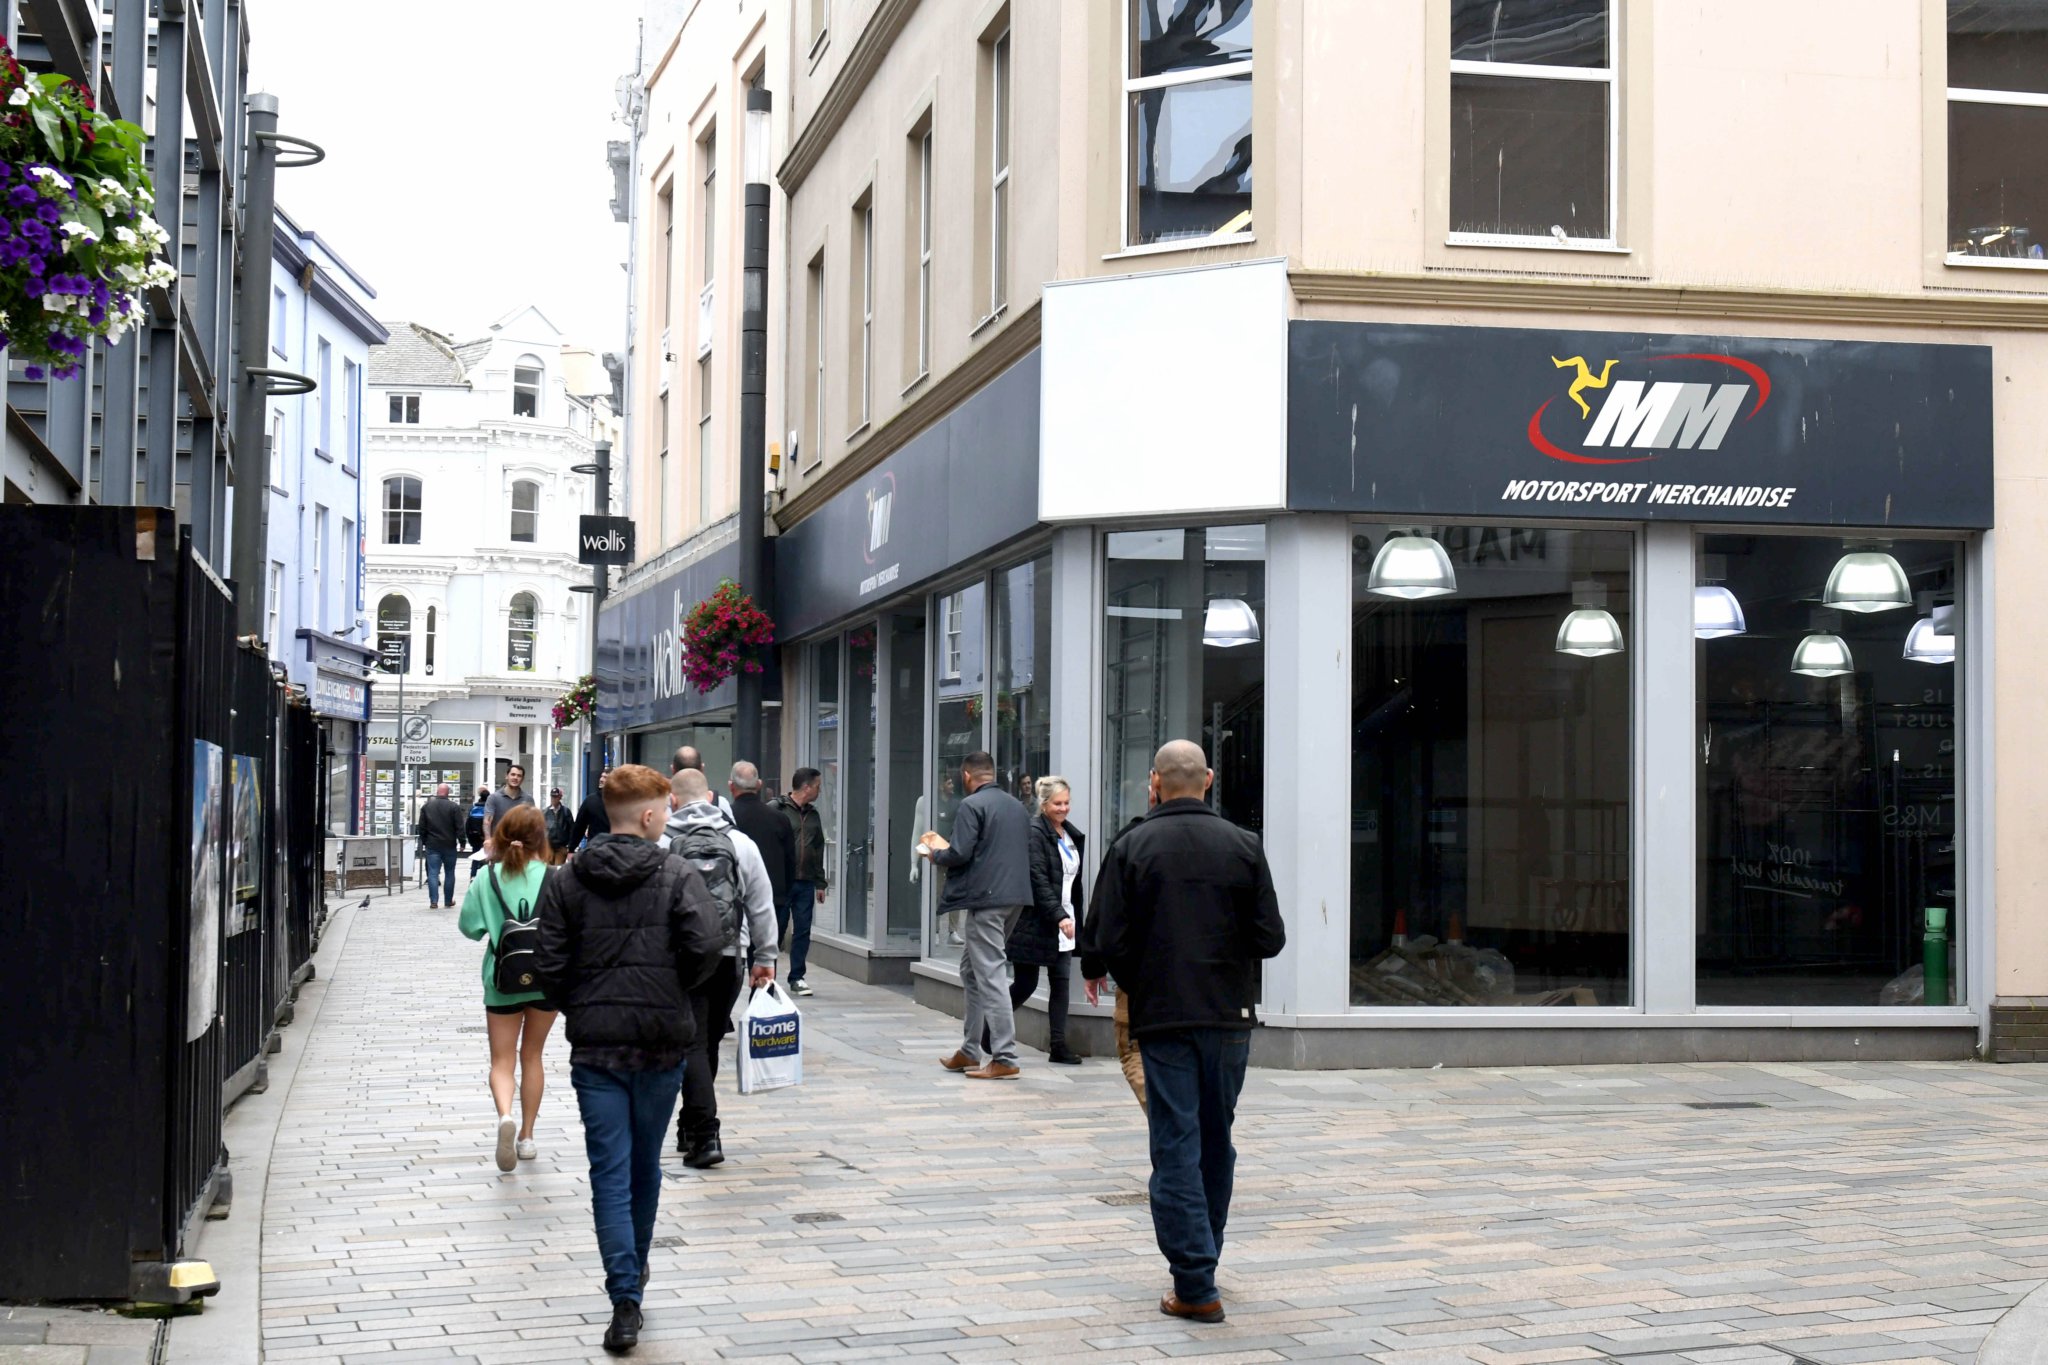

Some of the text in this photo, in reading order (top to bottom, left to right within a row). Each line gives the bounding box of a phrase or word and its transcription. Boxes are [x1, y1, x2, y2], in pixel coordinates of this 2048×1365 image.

[1582, 380, 1751, 450] MM
[1501, 479, 1797, 508] MOTORSPORT MERCHANDISE
[582, 529, 626, 551] wallis
[430, 738, 474, 747] HRYSTALS
[404, 755, 427, 763] ENDS
[753, 1020, 796, 1035] home
[753, 1034, 796, 1047] hardware
